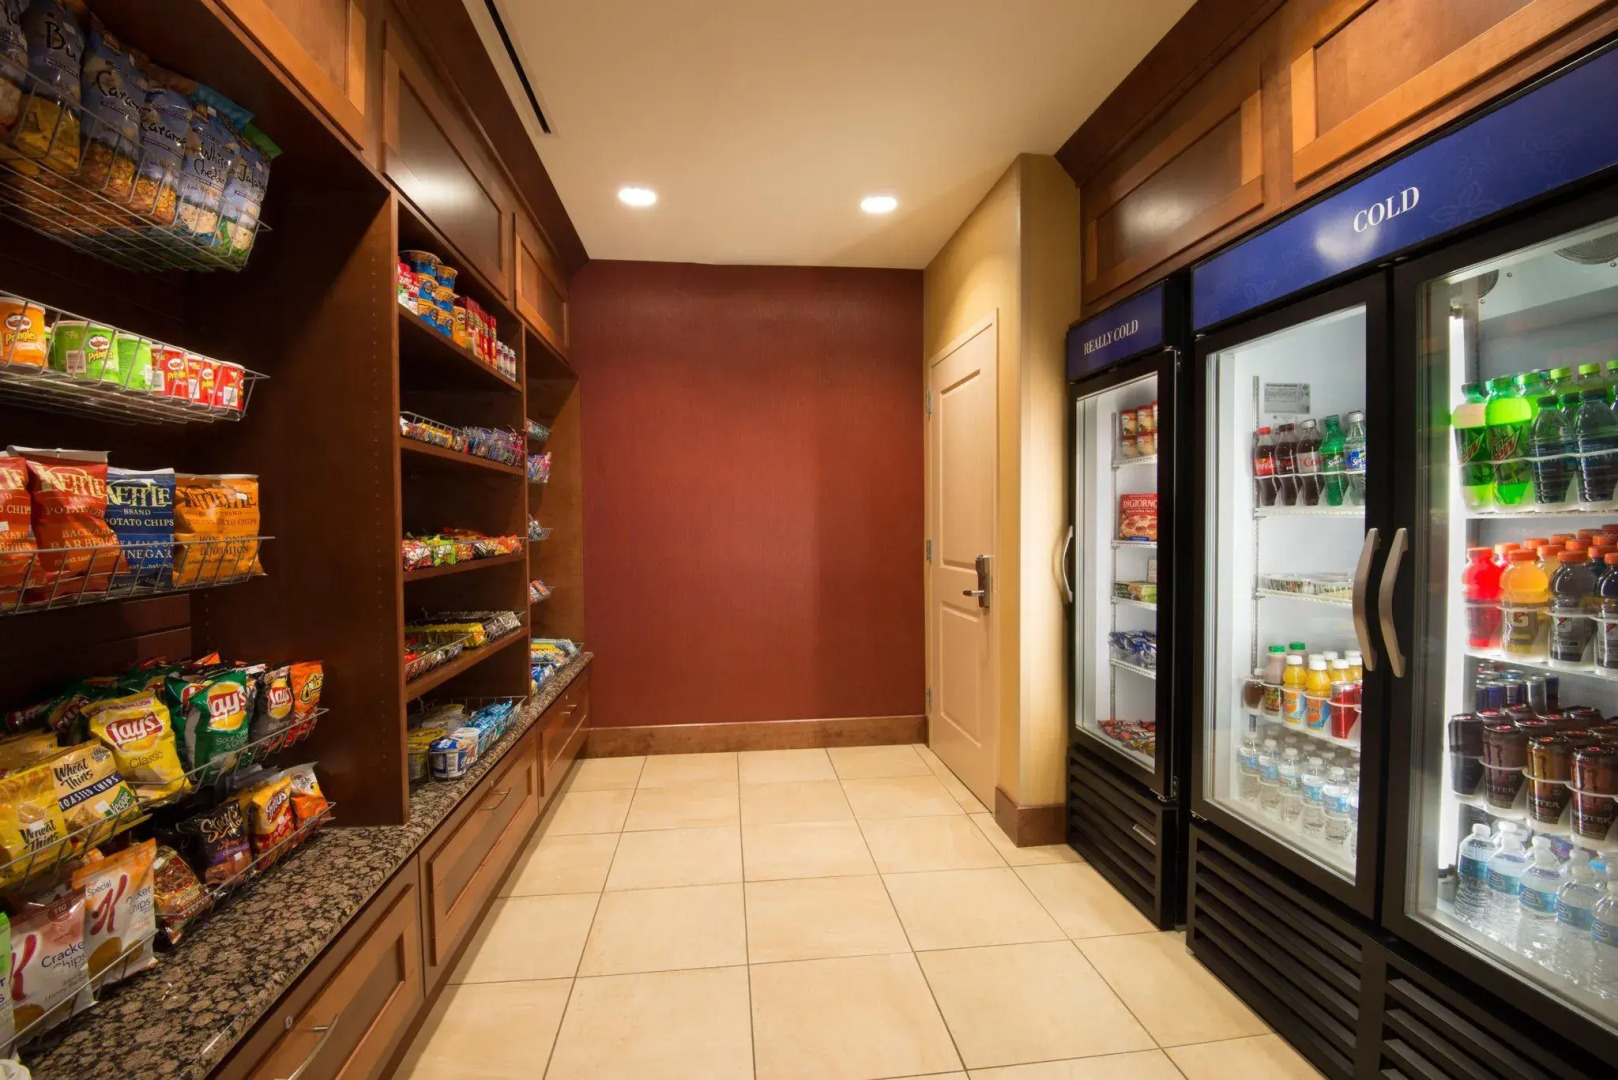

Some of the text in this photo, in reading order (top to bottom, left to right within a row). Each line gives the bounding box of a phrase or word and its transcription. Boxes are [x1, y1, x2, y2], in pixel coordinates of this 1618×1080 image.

[1353, 186, 1420, 233] COLD
[1083, 319, 1139, 356] REALLY COLD
[123, 508, 152, 516] BRAND
[144, 519, 175, 528] CHIPS
[110, 711, 161, 746] Lay's
[53, 757, 89, 782] Wheat
[129, 750, 164, 769] Classic
[60, 769, 94, 790] Thins
[60, 774, 120, 810] TOASTED CHIPS
[110, 790, 131, 815] Veggie
[87, 880, 112, 898] Special
